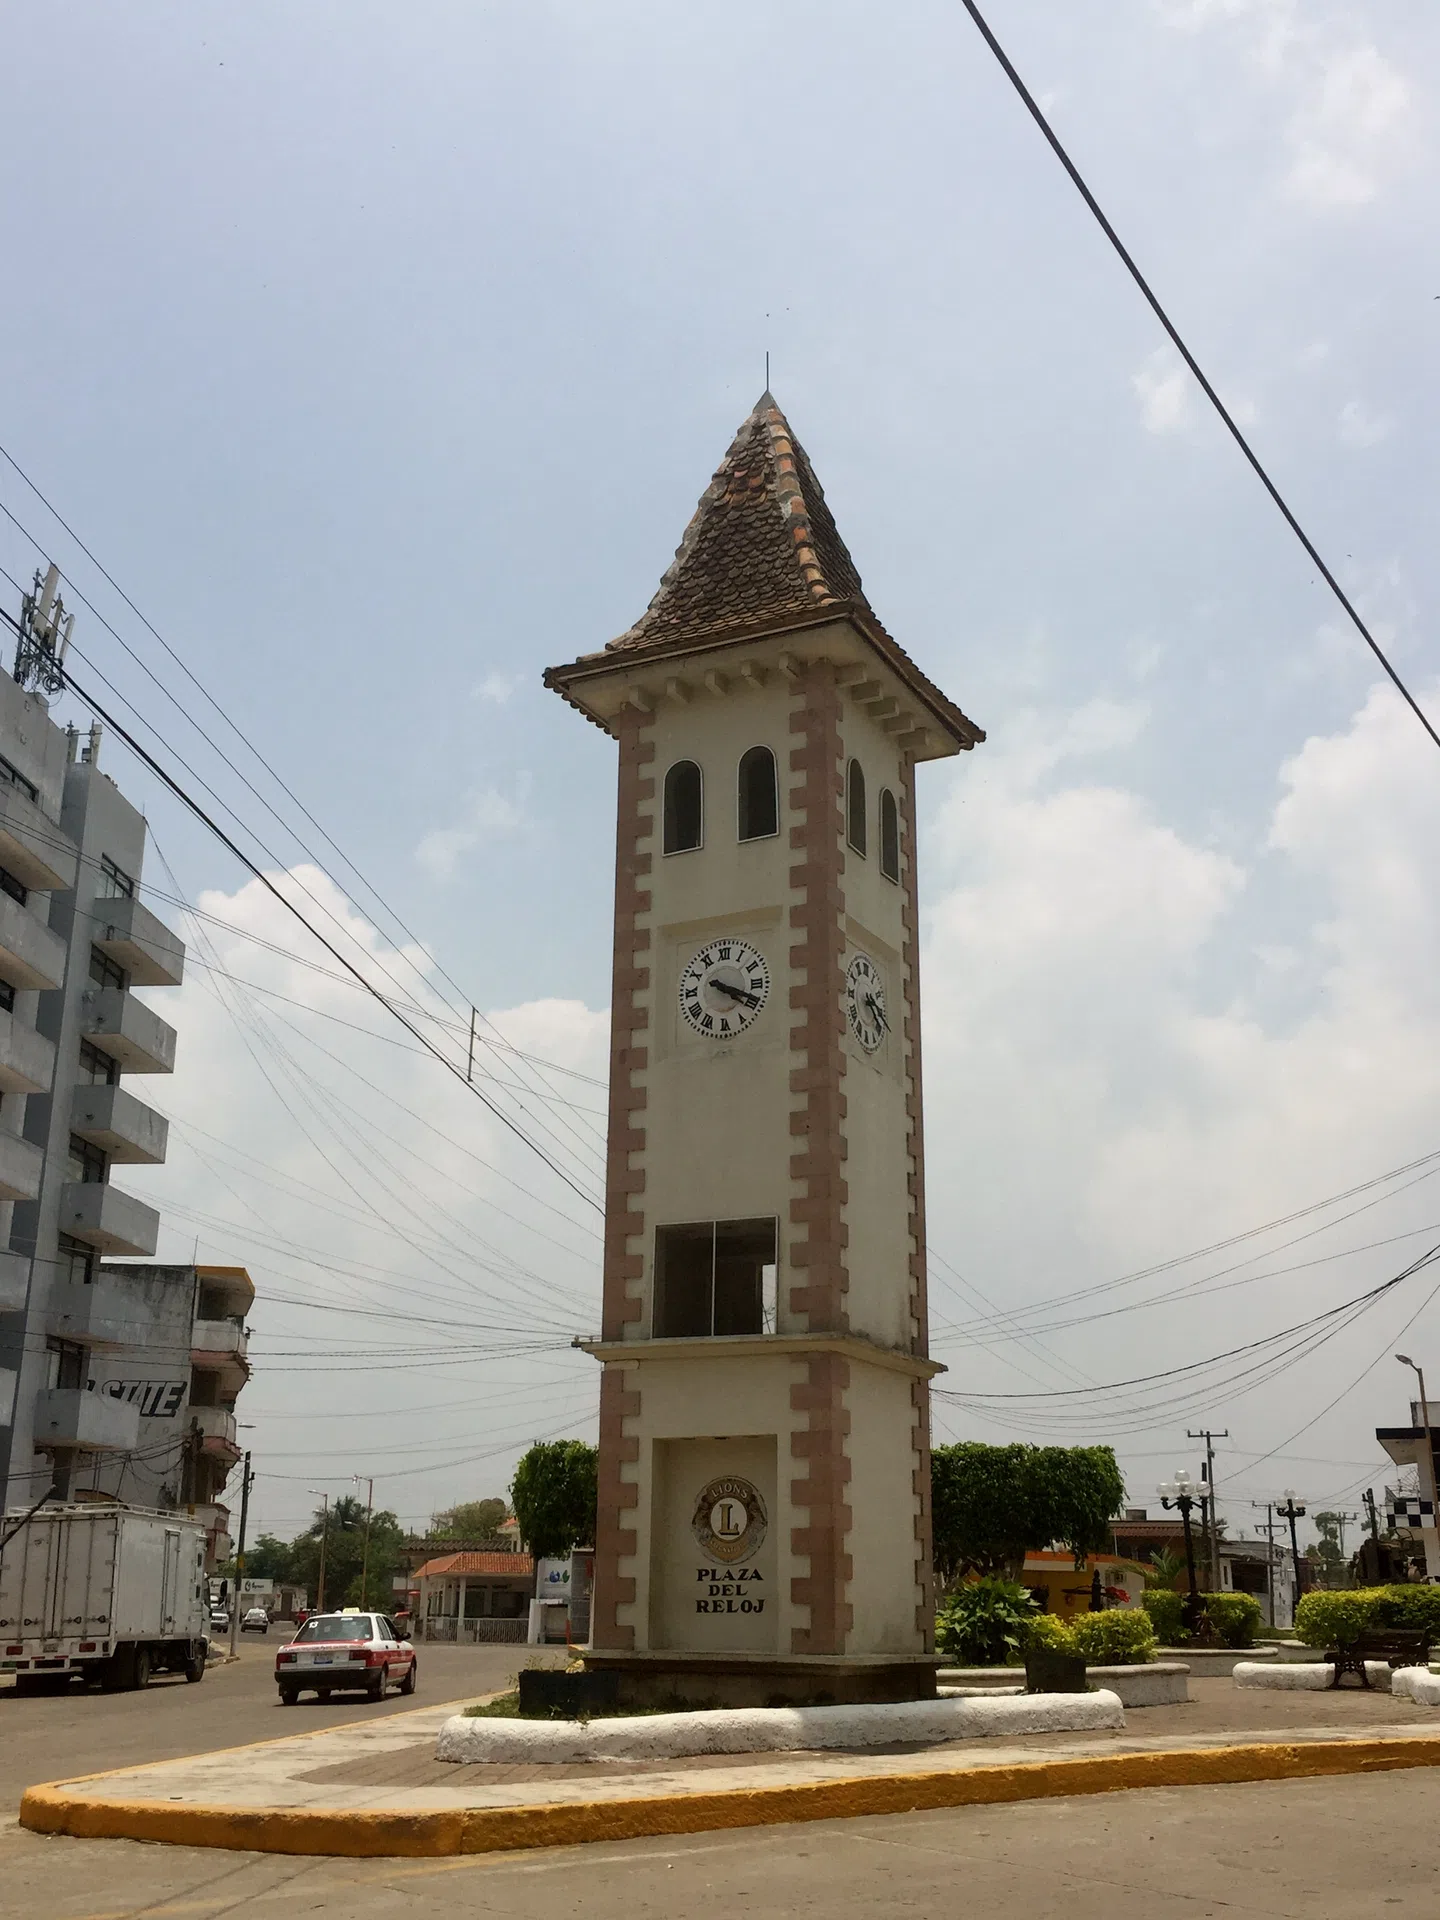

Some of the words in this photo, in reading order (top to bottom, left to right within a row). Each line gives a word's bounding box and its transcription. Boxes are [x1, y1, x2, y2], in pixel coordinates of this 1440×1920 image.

[711, 1482, 749, 1499] LIONS
[718, 1503, 740, 1535] L
[696, 1568, 764, 1581] PLAZA
[708, 1584, 748, 1597] DEL
[695, 1599, 766, 1614] RELOJ
